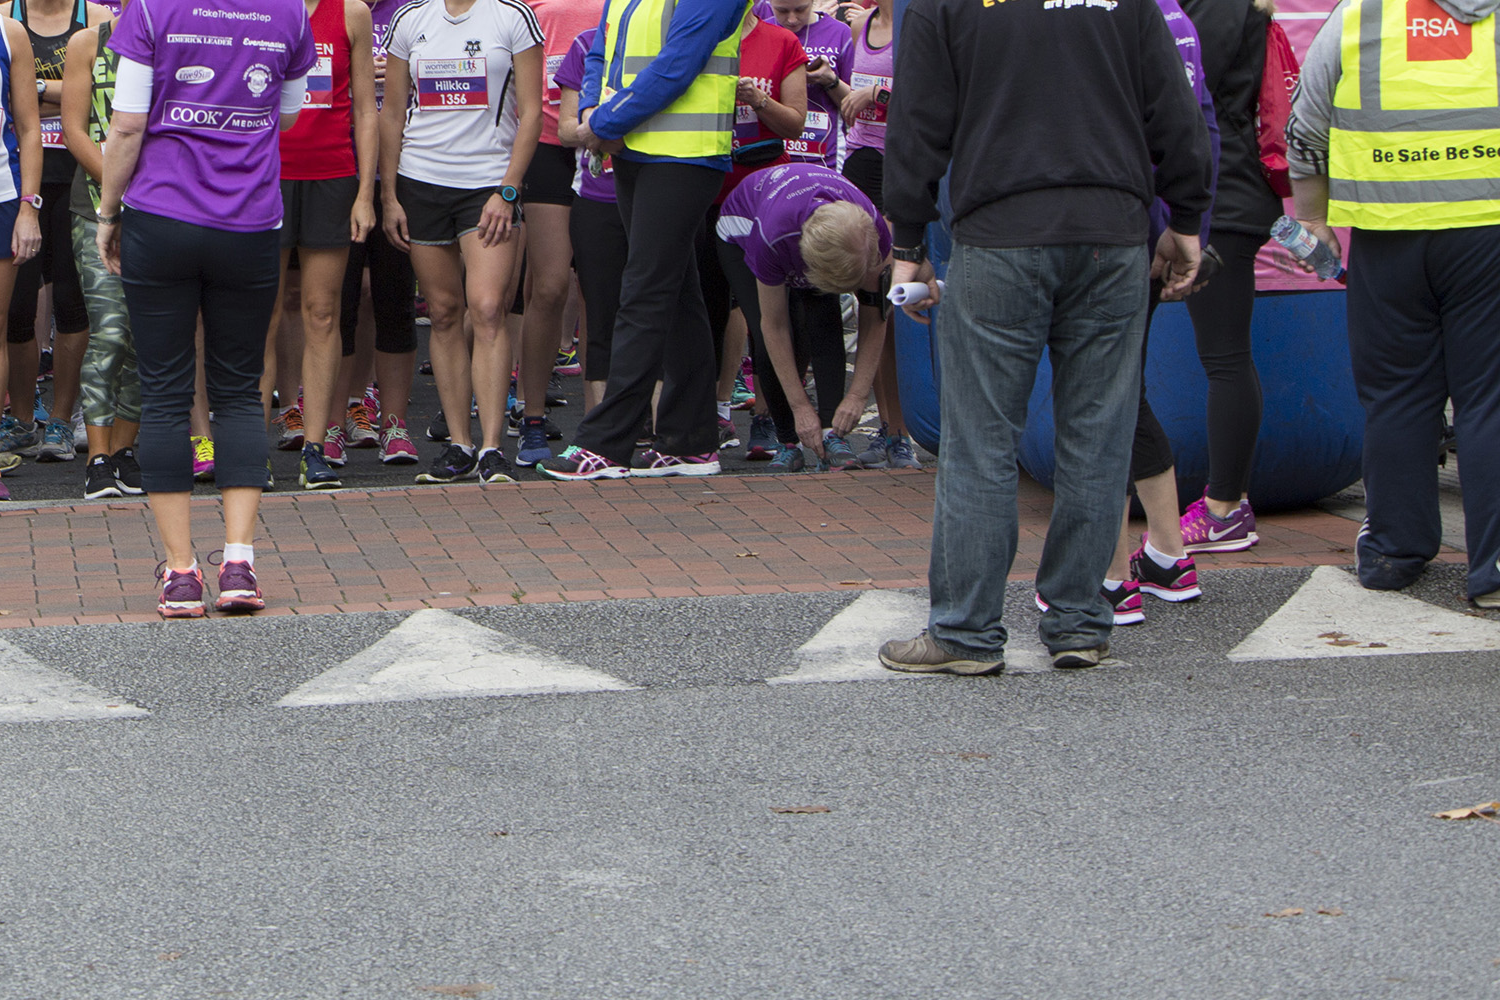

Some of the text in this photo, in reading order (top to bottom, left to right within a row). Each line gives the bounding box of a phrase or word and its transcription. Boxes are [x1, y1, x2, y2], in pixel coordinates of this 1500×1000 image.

[1043, 0, 1062, 10] are
[192, 8, 272, 24] #TakeTheNextStep
[1410, 18, 1459, 37] RSA
[167, 35, 233, 47] LIMERICK LEADER
[315, 43, 334, 55] EN
[424, 63, 457, 71] womens
[435, 80, 471, 92] Hilkka
[440, 93, 467, 105] 1356
[231, 118, 269, 127] MEDICAL
[1373, 145, 1500, 163] Be Safe Be Se
